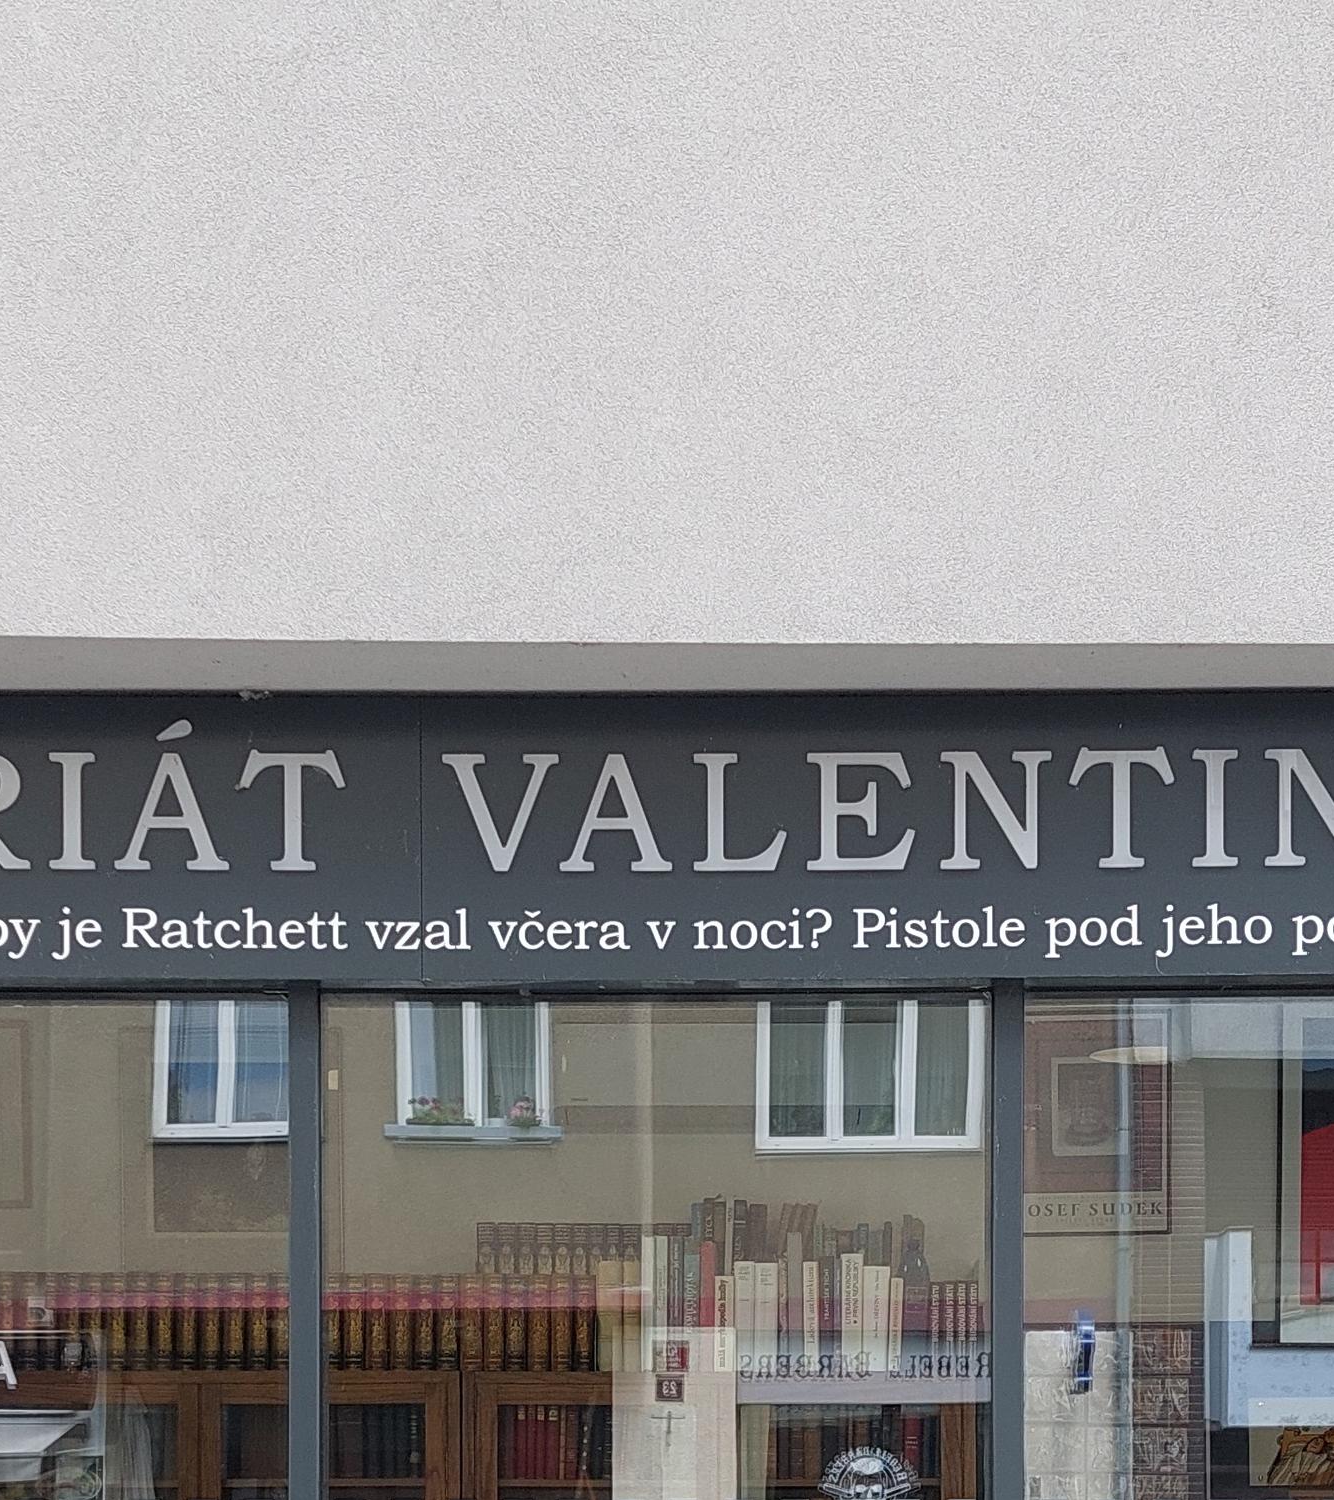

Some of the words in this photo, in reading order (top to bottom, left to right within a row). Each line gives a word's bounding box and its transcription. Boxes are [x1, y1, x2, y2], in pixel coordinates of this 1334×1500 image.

[55, 910, 101, 958] je
[121, 908, 350, 950] Ratchett
[369, 908, 470, 951] vzal
[490, 910, 628, 951] včera
[647, 921, 674, 950] v
[692, 907, 833, 950] noci?
[854, 907, 1025, 949] Pistole
[1045, 906, 1140, 957] pod
[1156, 904, 1272, 957] jeho
[1089, 1201, 1163, 1216] SUDEK
